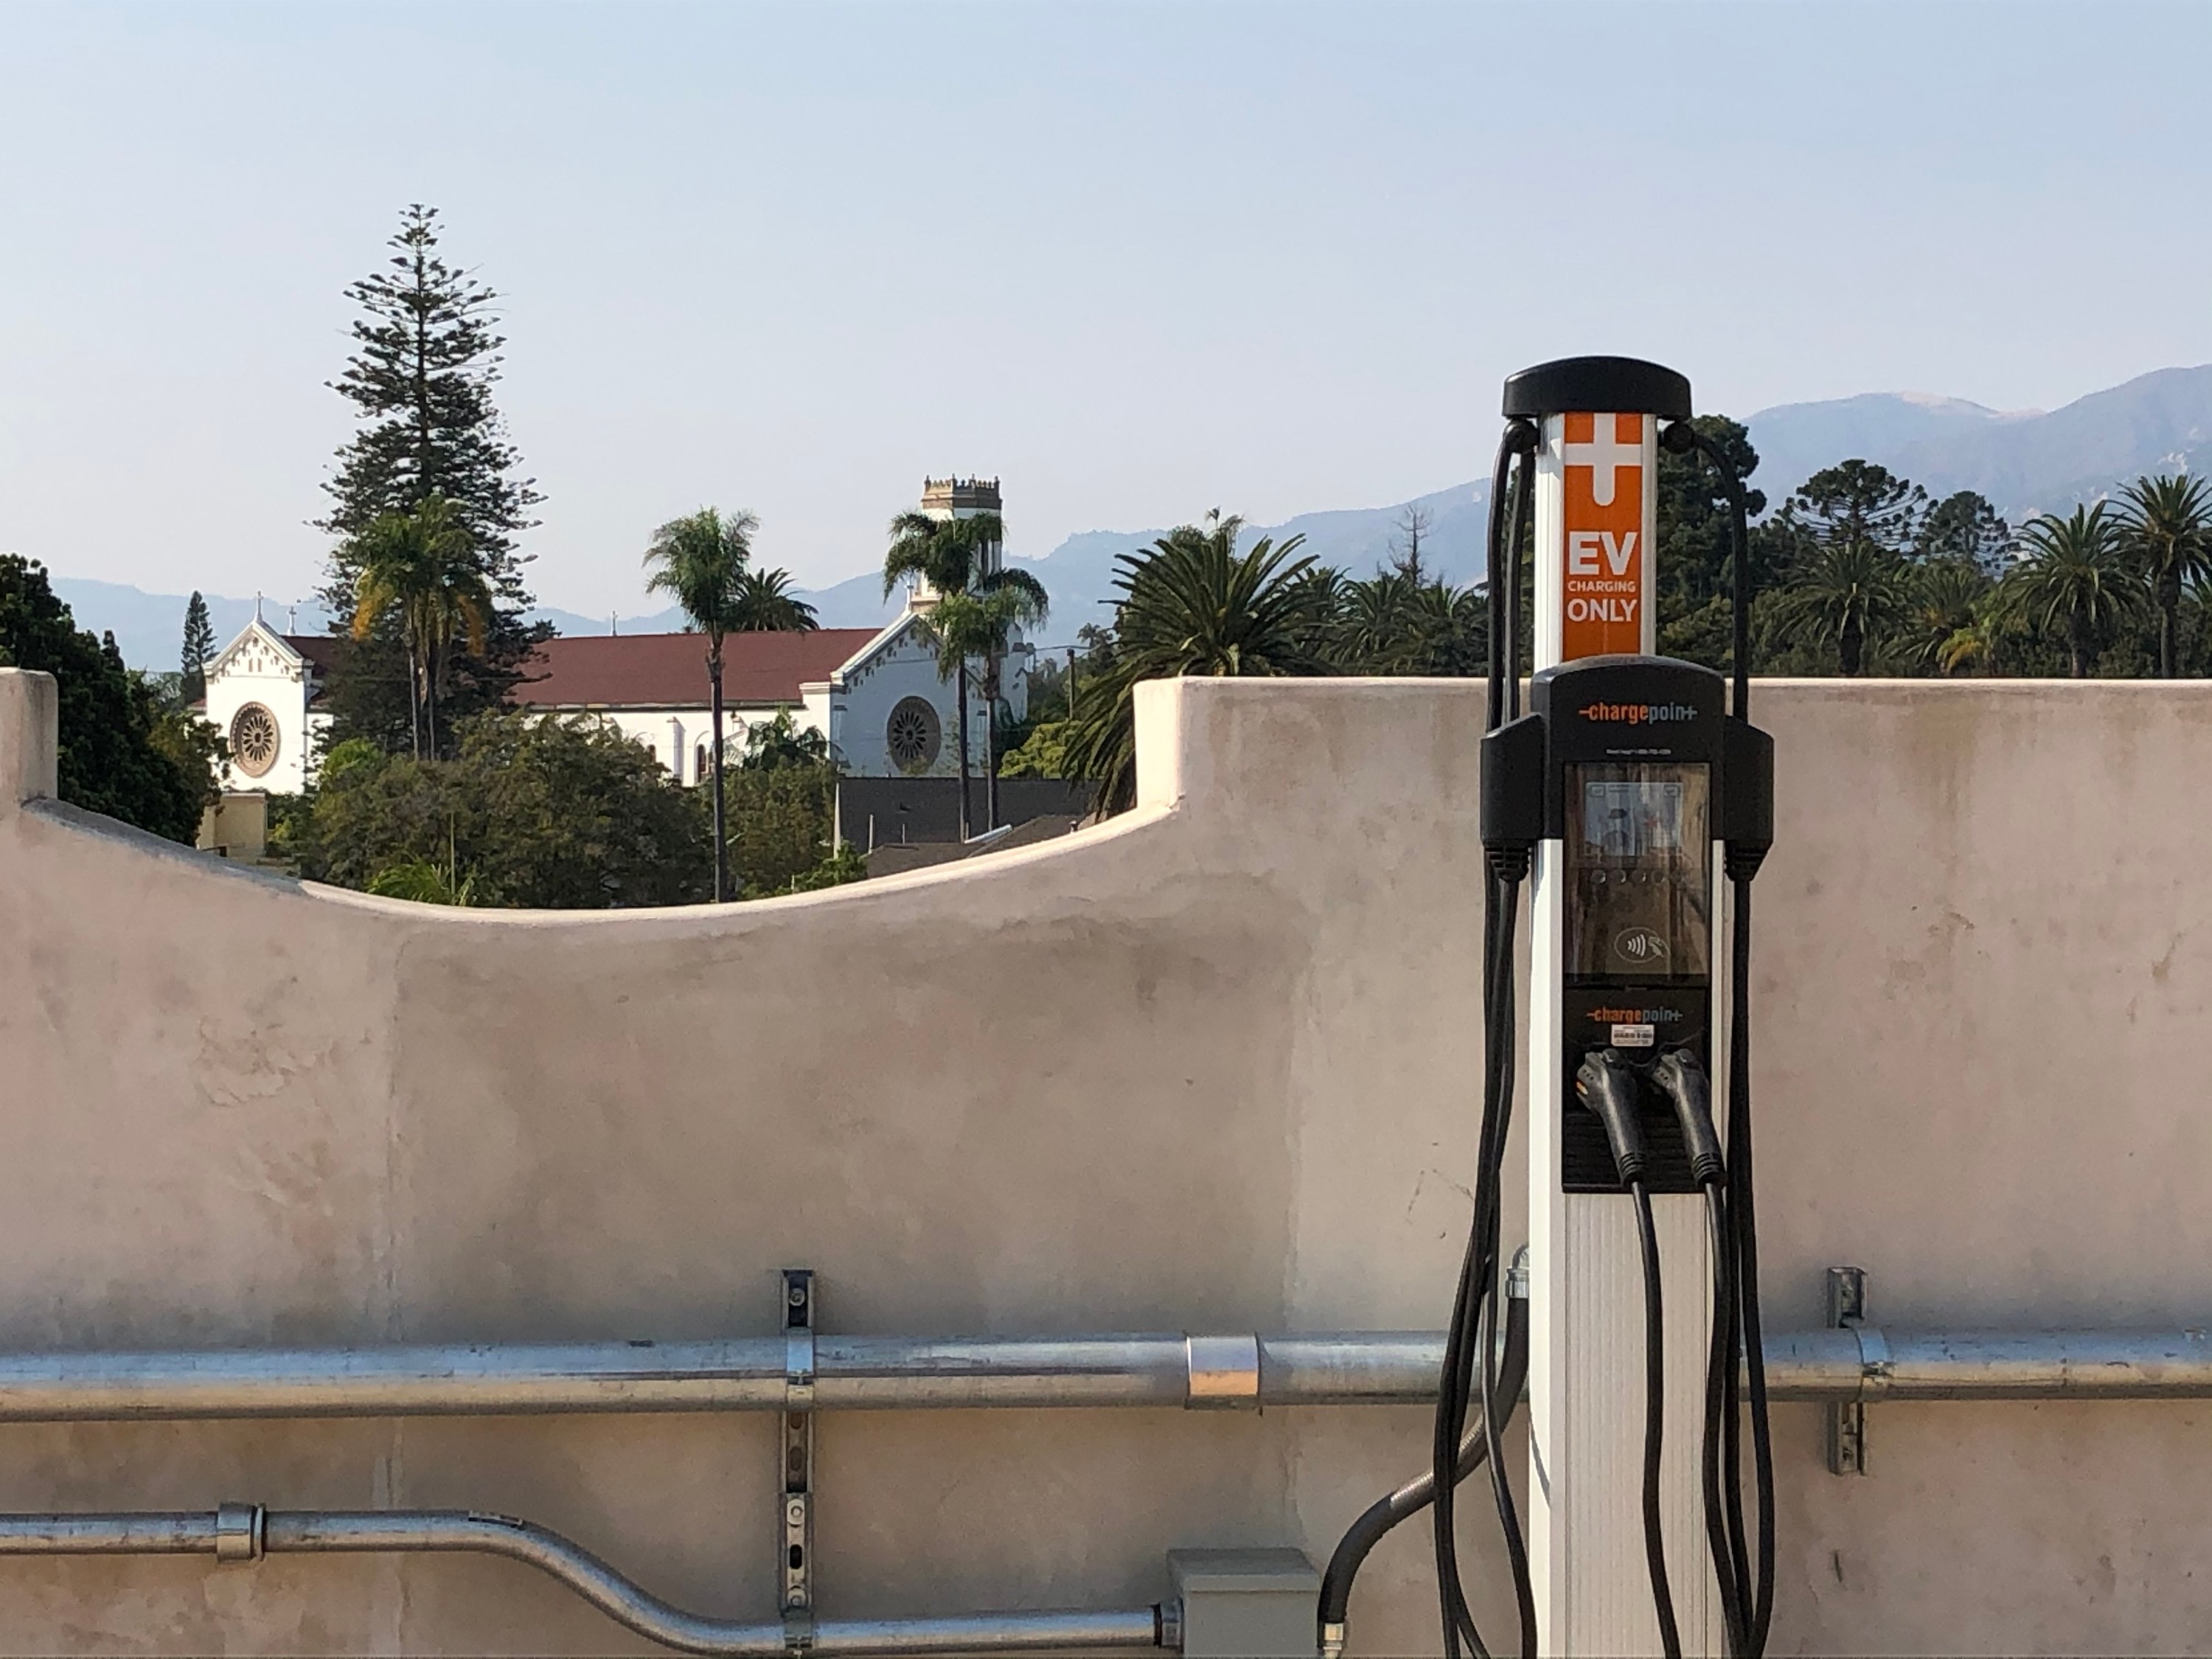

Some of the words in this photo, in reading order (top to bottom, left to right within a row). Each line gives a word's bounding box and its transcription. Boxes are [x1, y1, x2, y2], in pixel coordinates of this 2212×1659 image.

[1568, 531, 1638, 575] EV
[1568, 580, 1636, 593] CHARGING
[1568, 598, 1638, 622] ONLY
